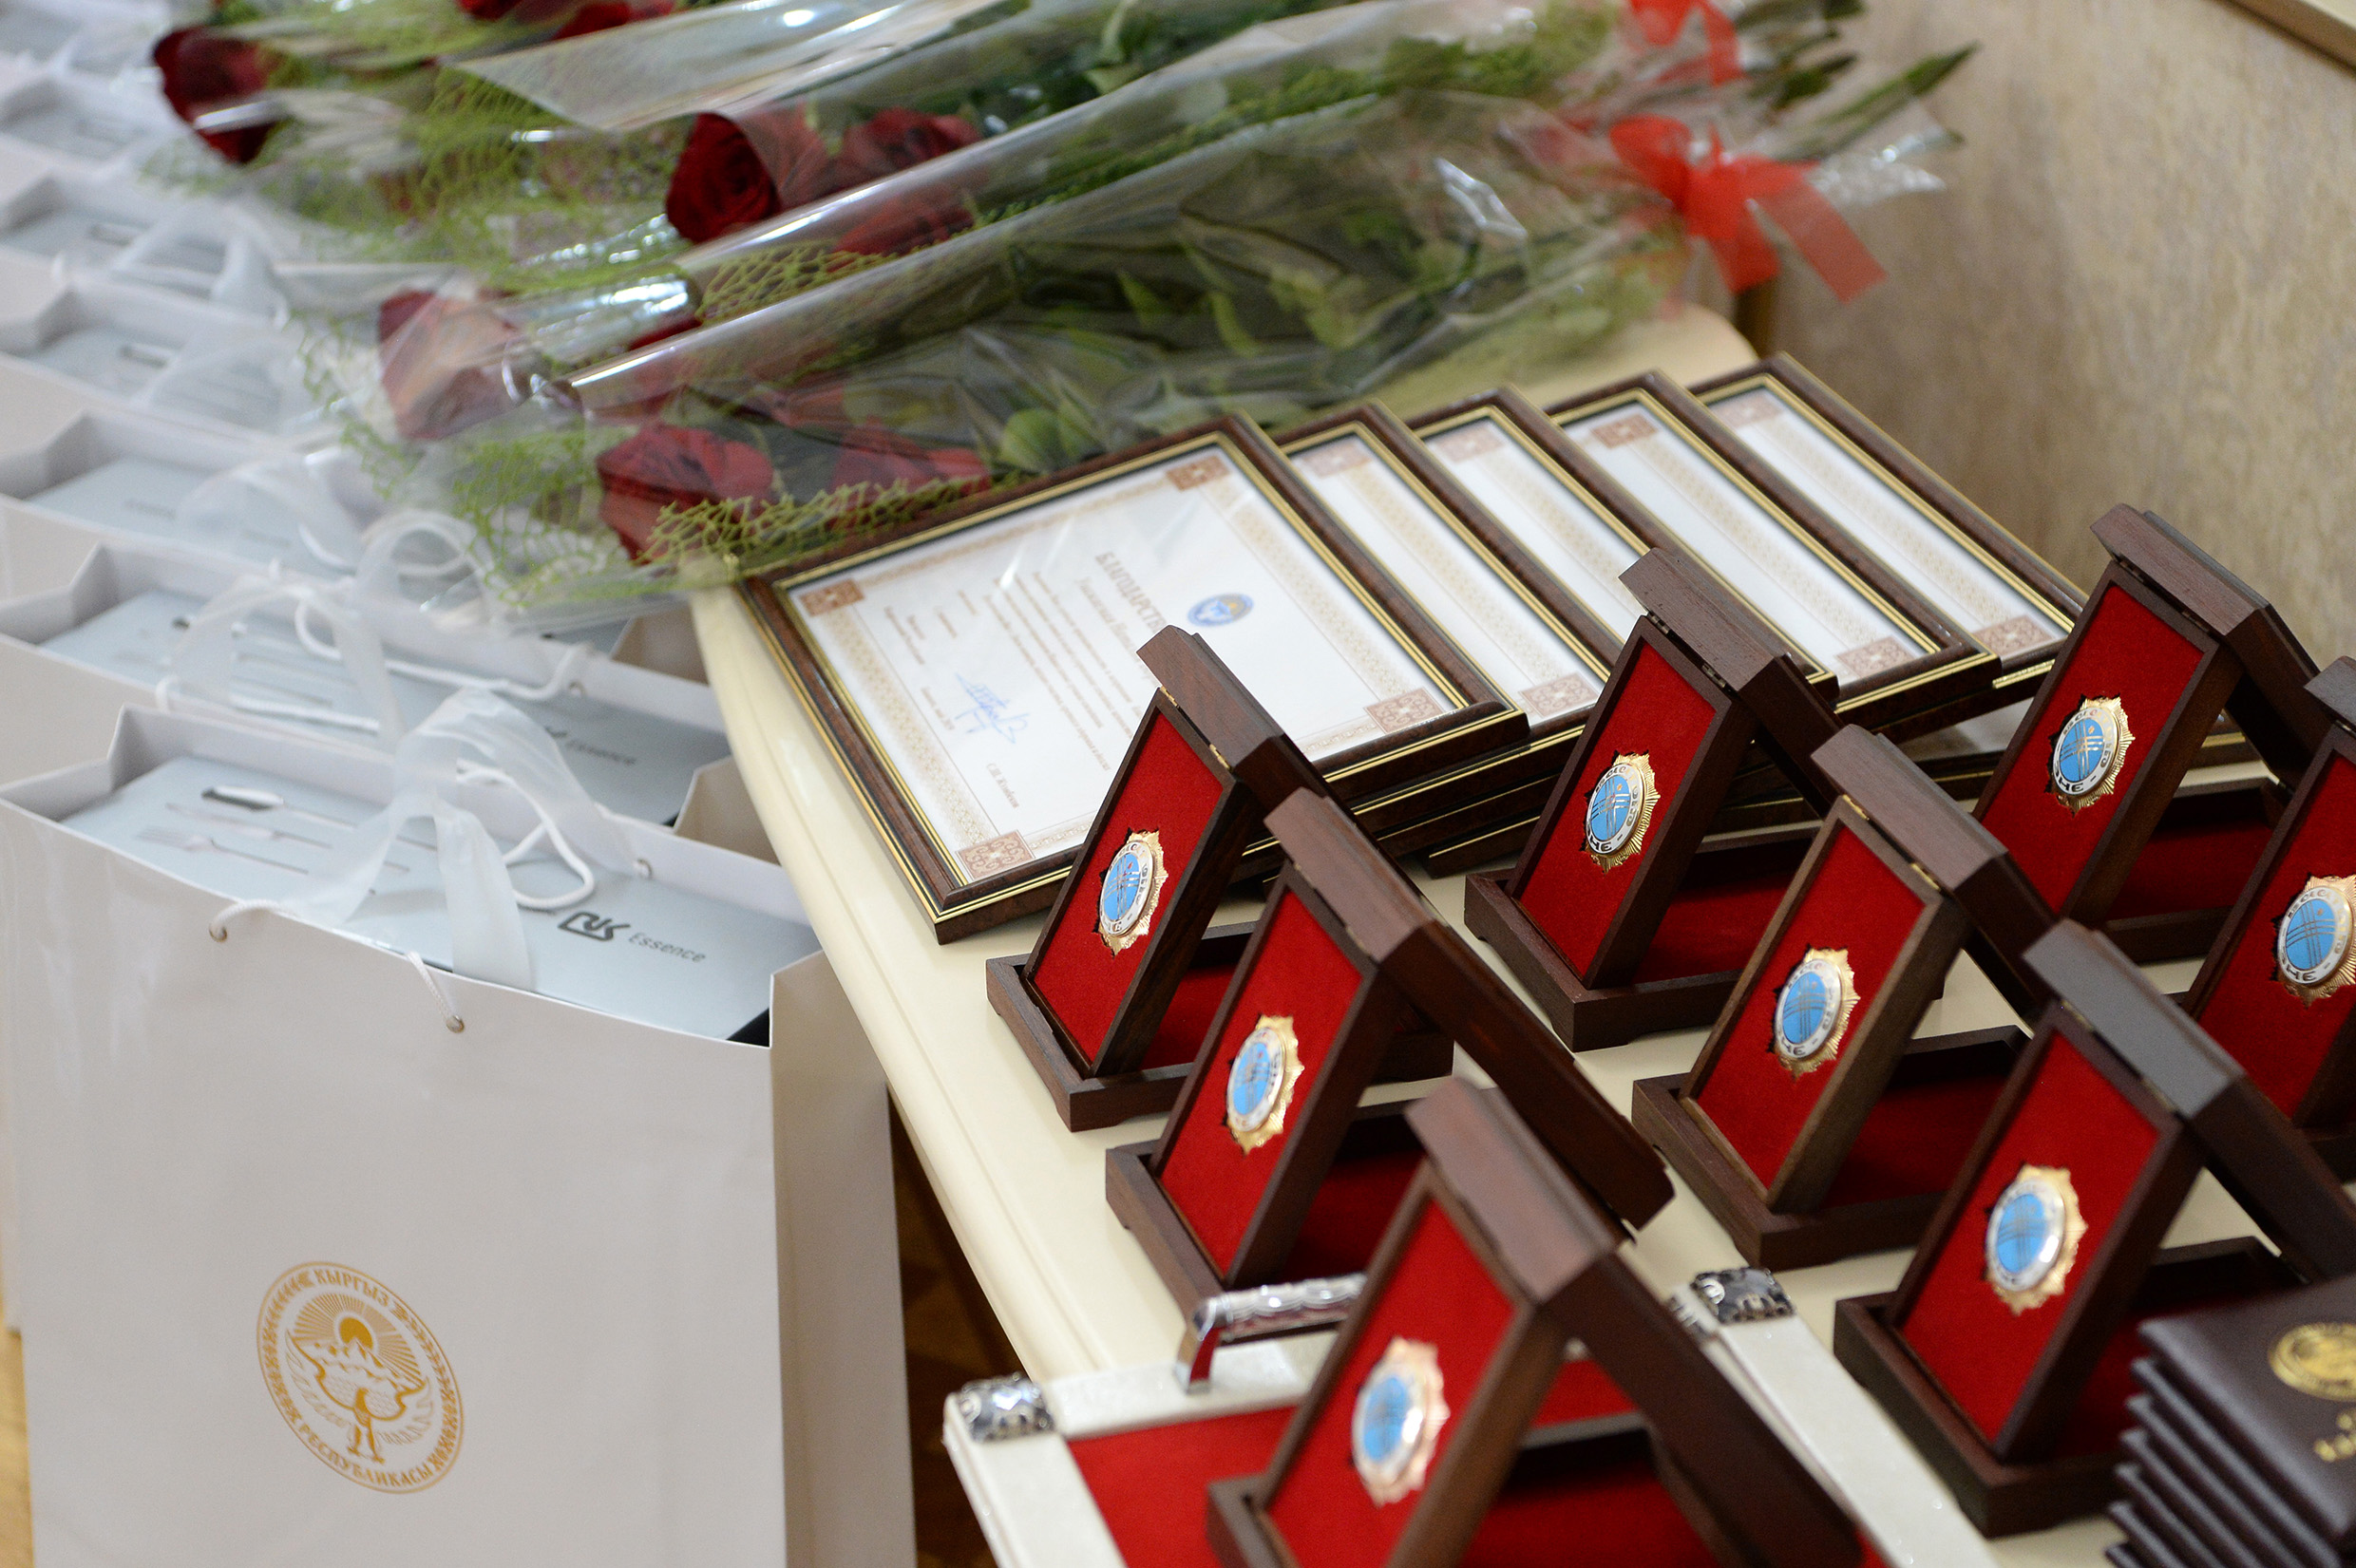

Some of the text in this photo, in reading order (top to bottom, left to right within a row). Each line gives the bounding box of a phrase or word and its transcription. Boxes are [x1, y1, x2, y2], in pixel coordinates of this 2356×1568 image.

[1094, 551, 1168, 634] БЛАГОДАРСТВ
[628, 931, 707, 963] Essence
[314, 1269, 391, 1308] КЫРГЫЗ
[297, 1425, 432, 1486] РЕСПУБЛИКАСЫ
